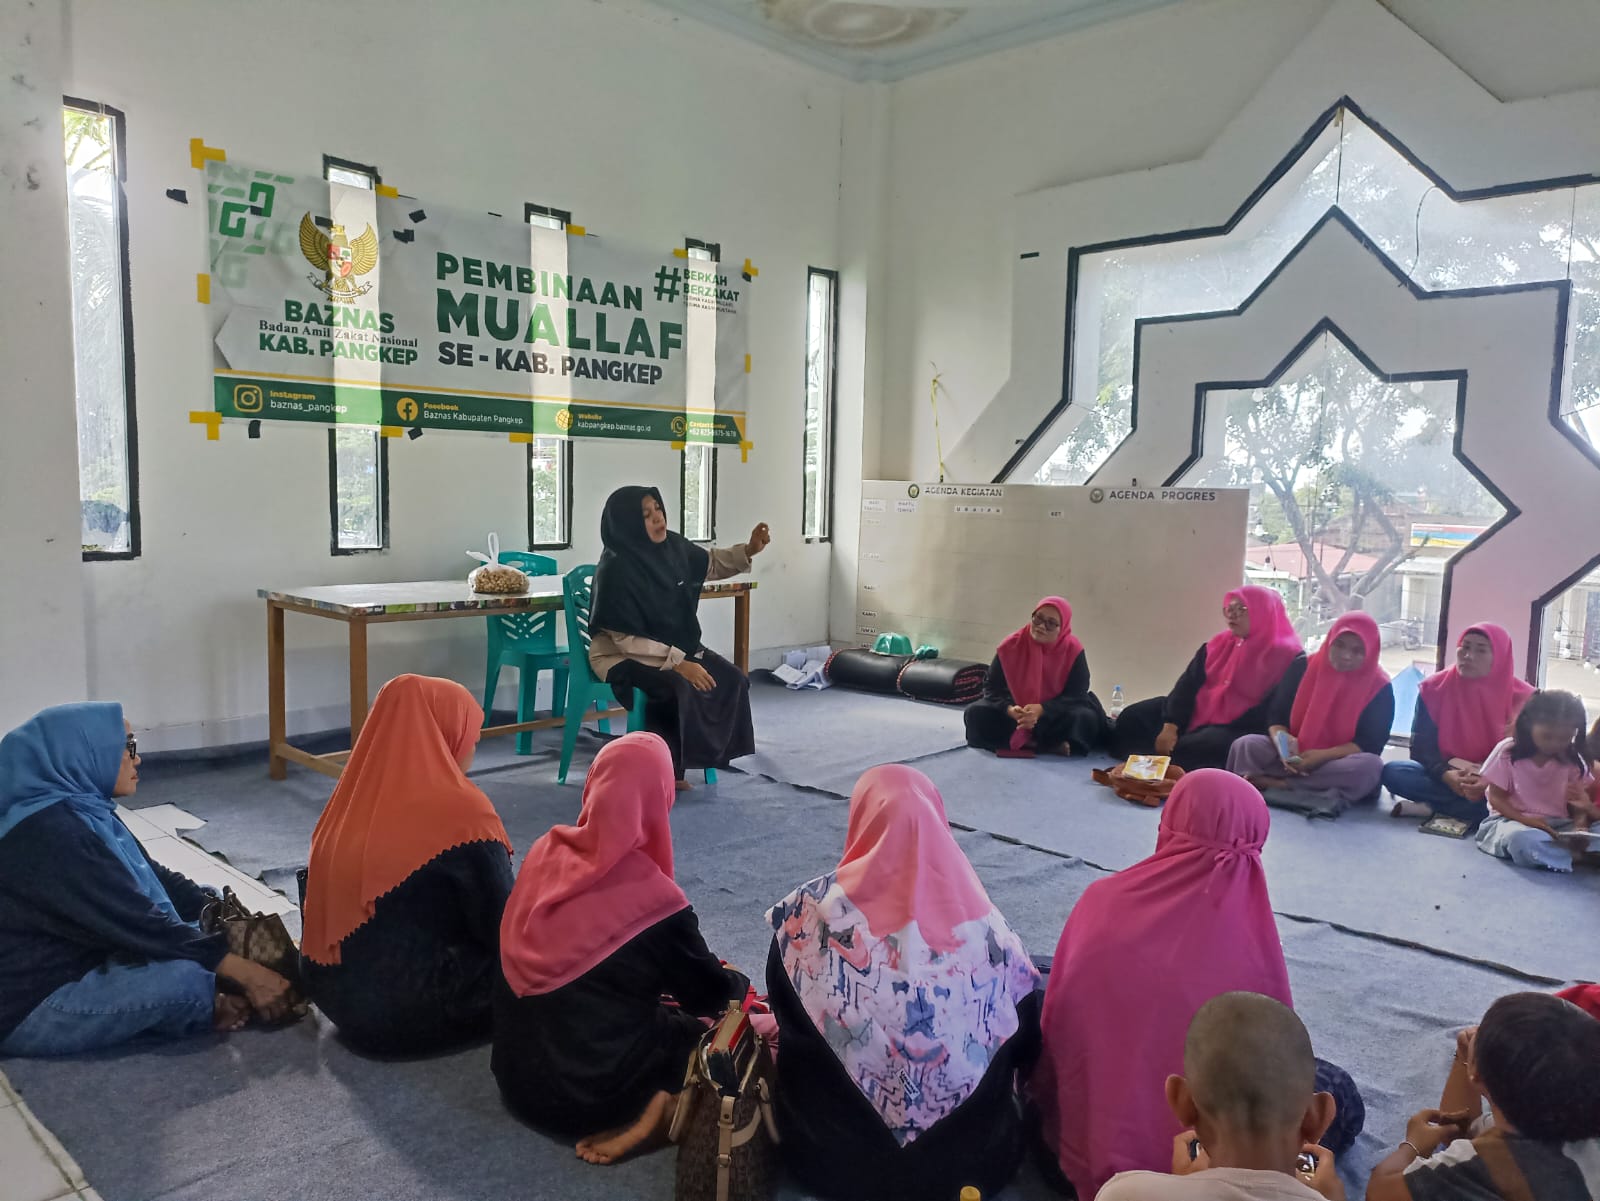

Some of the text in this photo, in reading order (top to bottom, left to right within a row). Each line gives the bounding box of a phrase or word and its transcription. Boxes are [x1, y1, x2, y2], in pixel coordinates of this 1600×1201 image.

[437, 252, 642, 311] PEMBINAAN
[684, 268, 727, 286] BERKAH
[684, 283, 739, 302] BERZAKAT
[284, 299, 395, 333] BAZNAS
[437, 287, 682, 360] MUALLAF
[259, 320, 418, 348] Badan Amil Zakat Nasional
[259, 332, 418, 365] KAB. PANGKEP
[495, 347, 554, 374] KAB.
[561, 355, 663, 385] PANGKEP
[269, 390, 316, 400] Instagram
[270, 400, 347, 414] baznas_pangkep
[423, 410, 524, 425] Baznas Kabupaten Pangkep
[925, 486, 1002, 497] AGENDA KEGIATAN
[1109, 490, 1216, 501] AGENDA PROGRES
